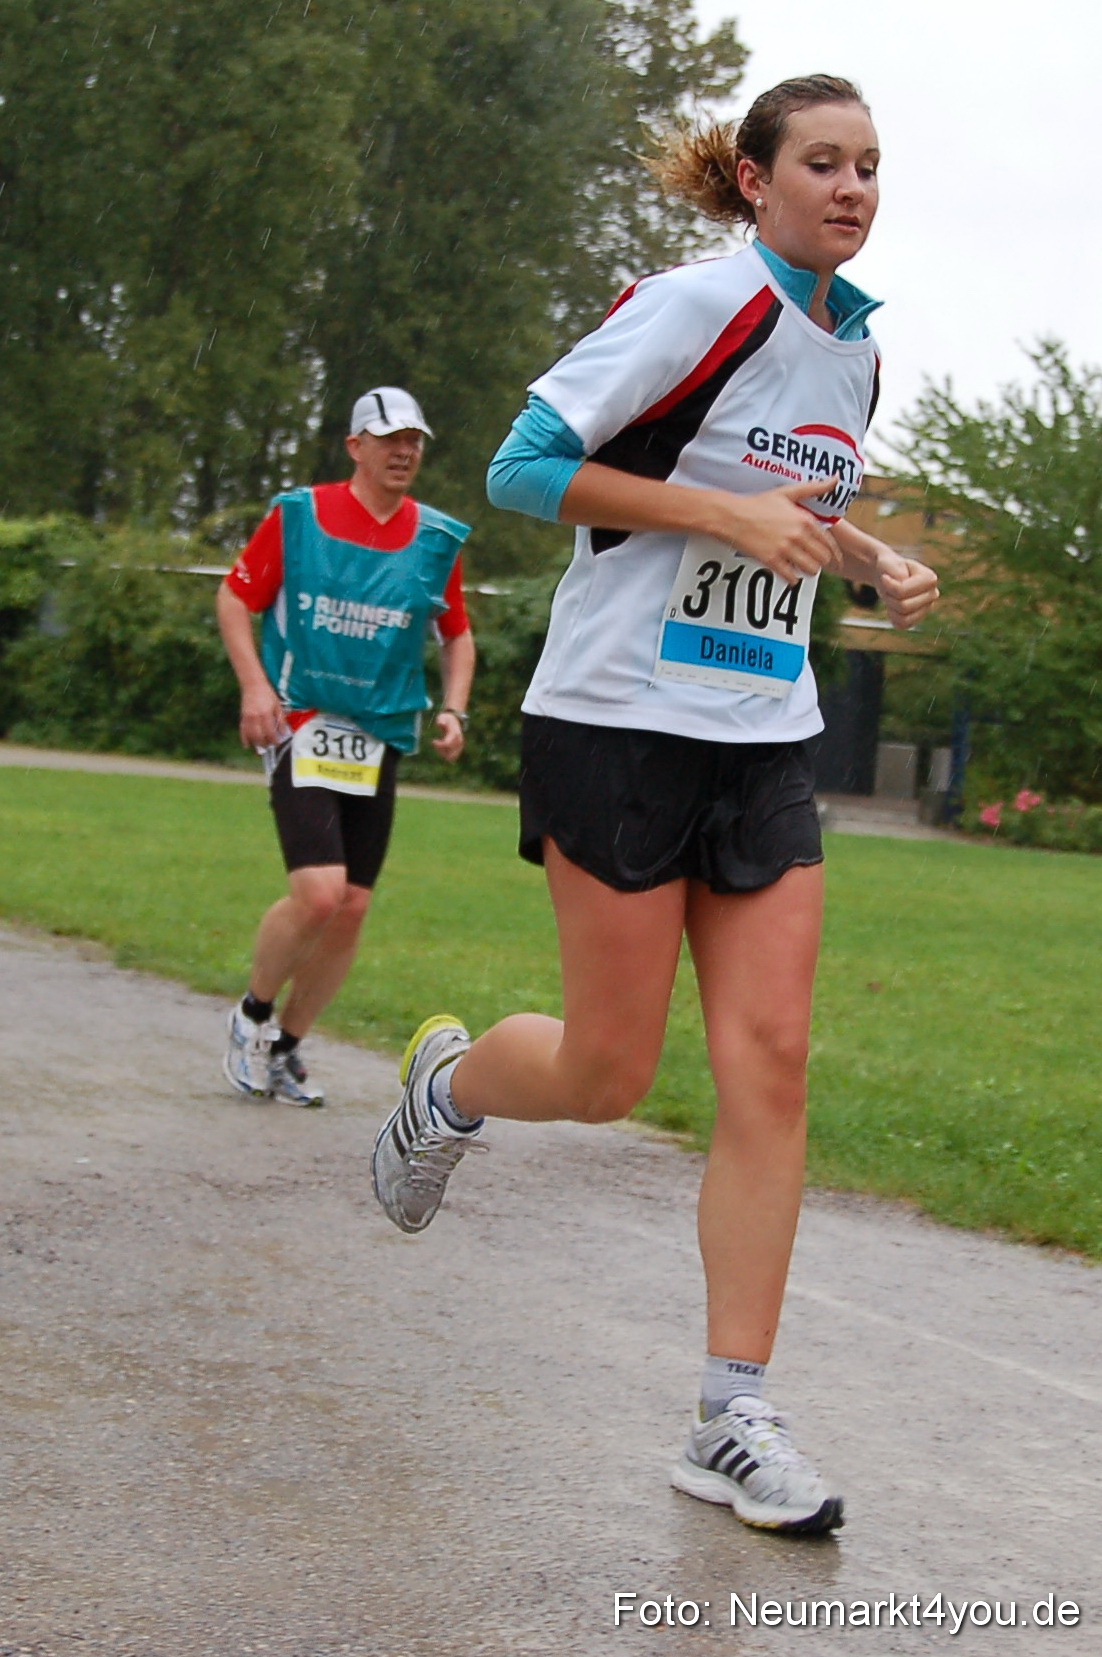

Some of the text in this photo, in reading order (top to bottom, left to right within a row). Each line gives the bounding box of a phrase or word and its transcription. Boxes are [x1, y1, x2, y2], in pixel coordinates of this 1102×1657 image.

[740, 452, 802, 482] Autohaus
[746, 426, 856, 484] GERHART
[314, 594, 413, 629] RUNNERS
[682, 560, 804, 635] 3104
[312, 613, 379, 640] POINT
[701, 635, 773, 670] Daniela
